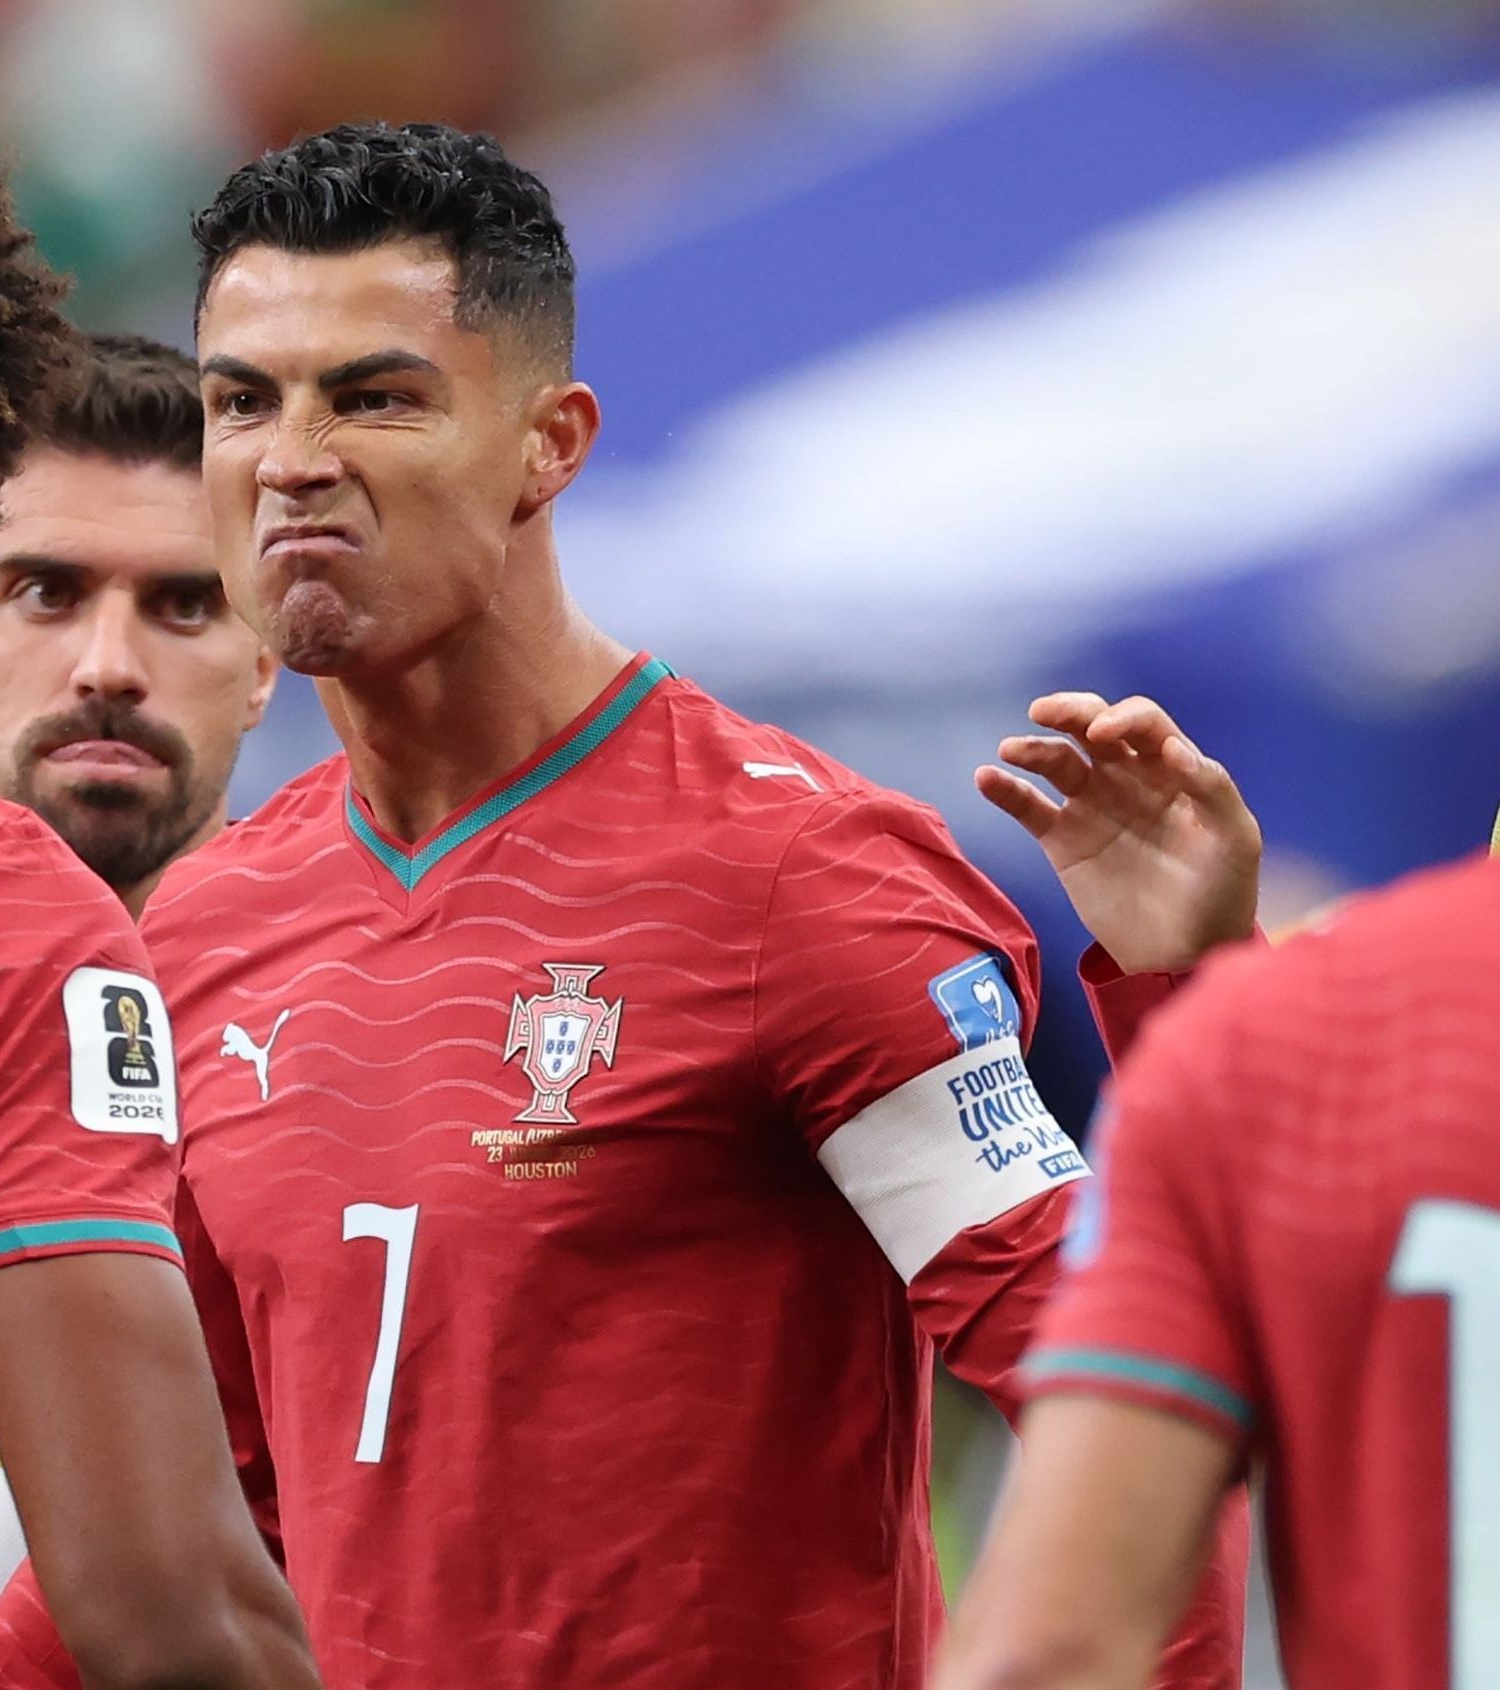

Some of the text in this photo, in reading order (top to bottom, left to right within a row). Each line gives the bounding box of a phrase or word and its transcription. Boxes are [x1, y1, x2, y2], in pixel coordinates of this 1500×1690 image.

[122, 1066, 152, 1081] FIFA
[487, 1146, 504, 1163] 23
[975, 1140, 1032, 1172] the
[504, 1161, 577, 1180] HOUSTON
[342, 1202, 419, 1463] 7
